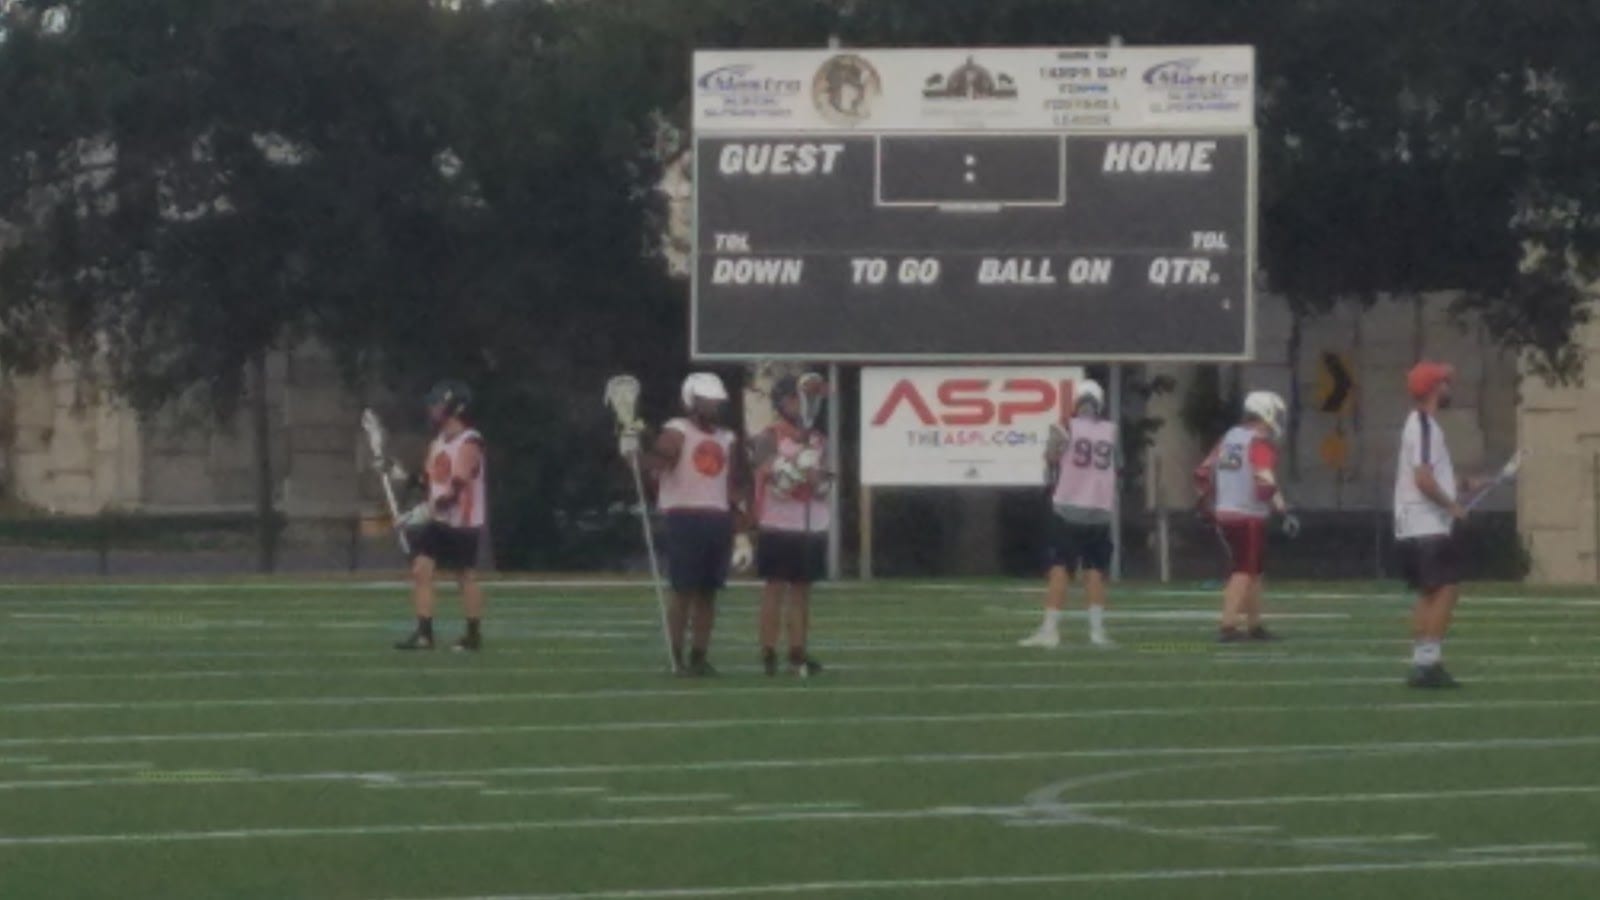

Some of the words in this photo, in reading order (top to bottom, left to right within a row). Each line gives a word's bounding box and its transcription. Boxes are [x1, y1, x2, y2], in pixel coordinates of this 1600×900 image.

[719, 143, 845, 174] GUEST
[1103, 141, 1217, 172] HOME
[712, 259, 803, 284] DOWN
[851, 259, 888, 284] TO
[898, 259, 940, 284] GO
[977, 258, 1056, 284] BALL
[1068, 258, 1113, 284] ON
[1148, 257, 1221, 285] QTR.
[1074, 437, 1113, 471] 99
